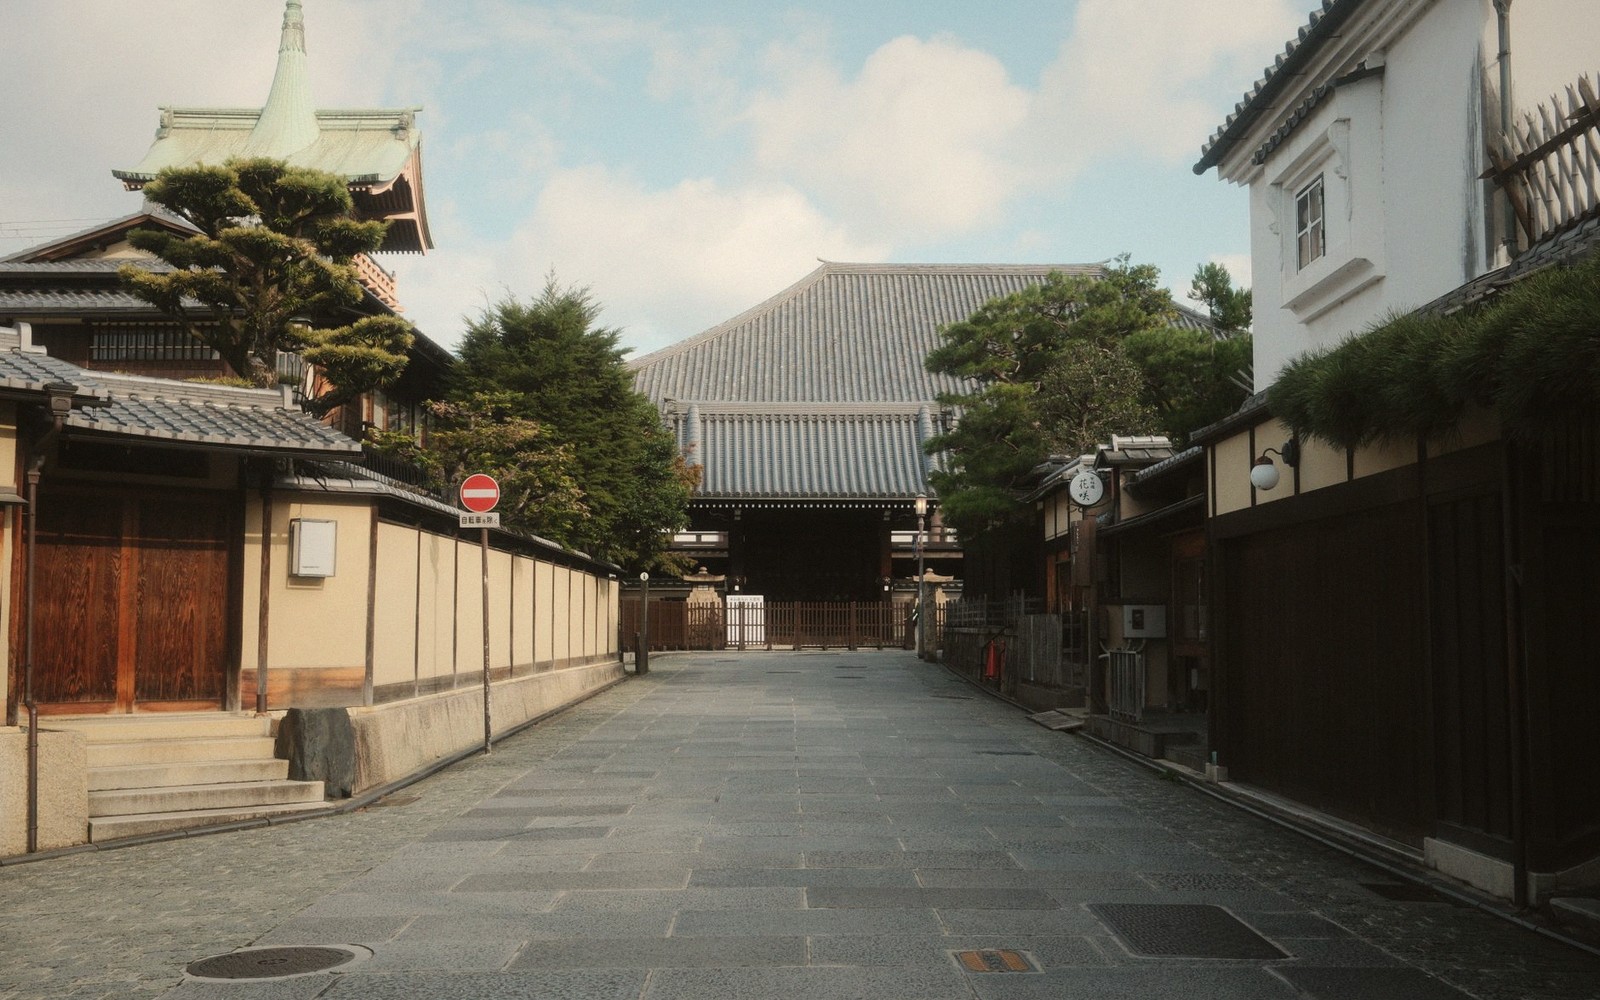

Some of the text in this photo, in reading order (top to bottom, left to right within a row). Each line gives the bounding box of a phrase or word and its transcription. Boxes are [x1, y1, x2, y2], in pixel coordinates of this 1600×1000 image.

[1079, 478, 1090, 501] 花咲
[461, 516, 499, 525] 自転車を除く
